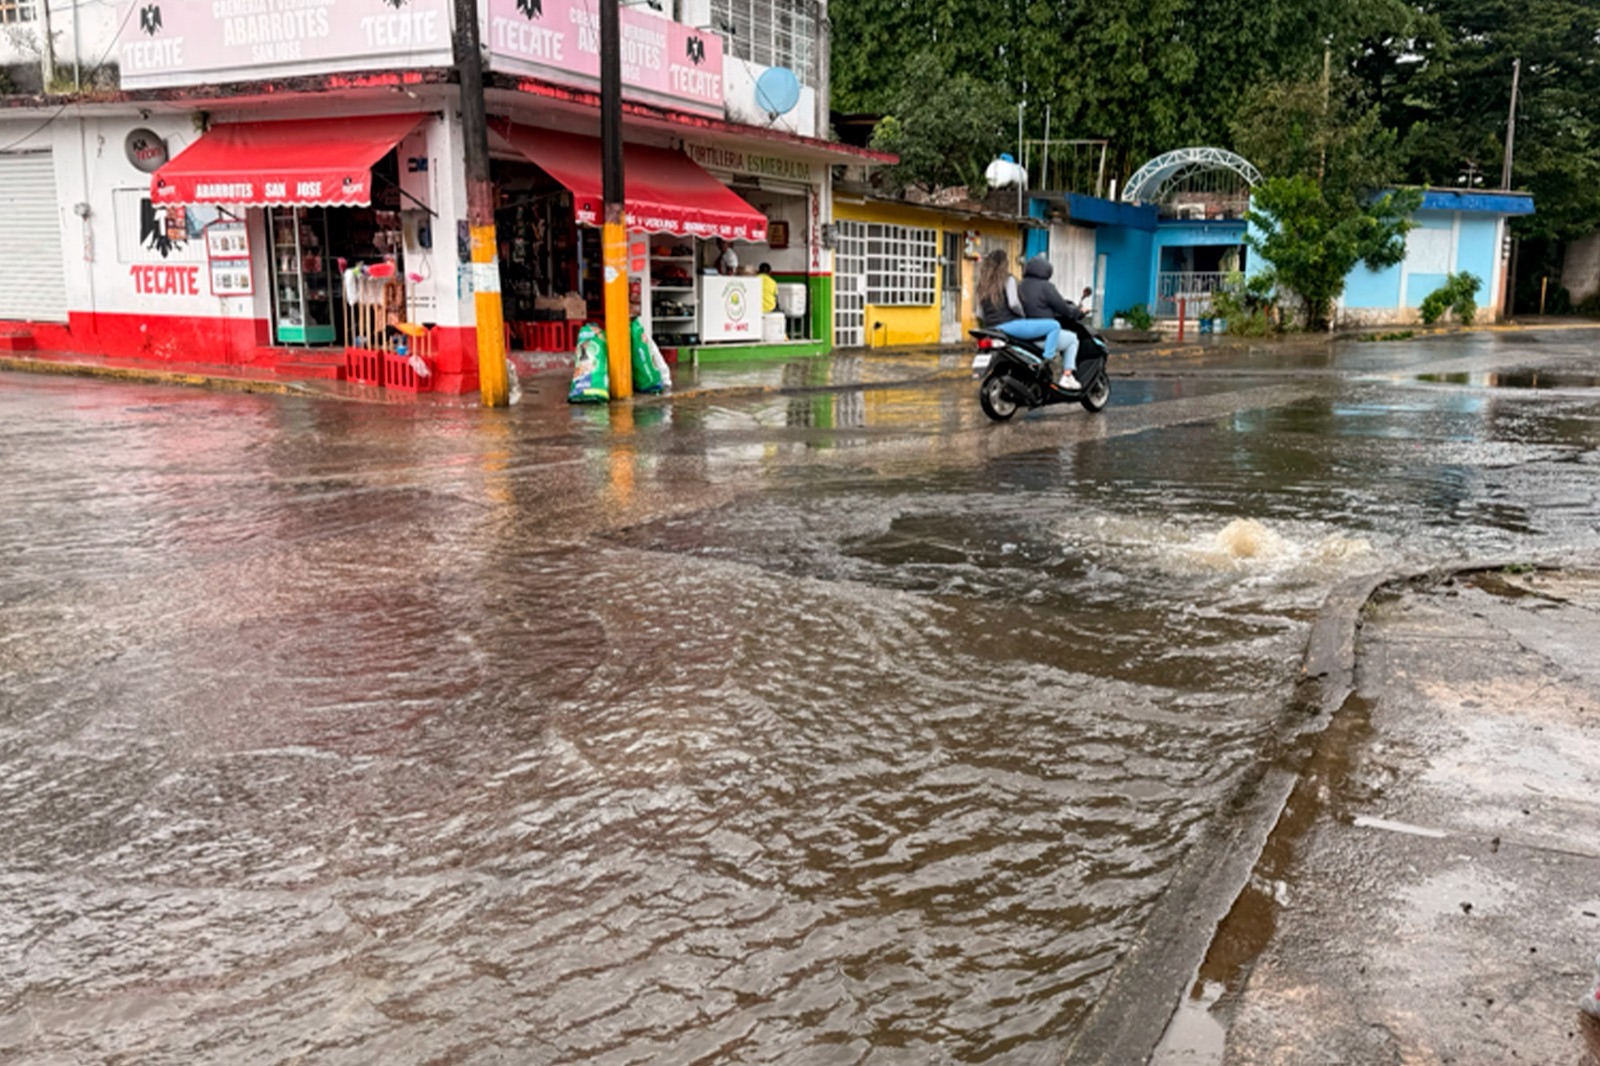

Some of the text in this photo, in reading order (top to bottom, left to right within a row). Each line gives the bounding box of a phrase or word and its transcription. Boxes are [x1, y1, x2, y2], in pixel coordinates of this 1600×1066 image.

[223, 7, 330, 46] ABARROTES
[359, 11, 438, 47] TECATE
[491, 16, 565, 61] TECATE
[122, 36, 184, 70] TECATE
[669, 63, 721, 99] TECATE
[747, 153, 811, 180] ESMERALDA
[195, 181, 322, 198] ABARROTES SAN JOSE
[130, 264, 200, 296] TECATE
